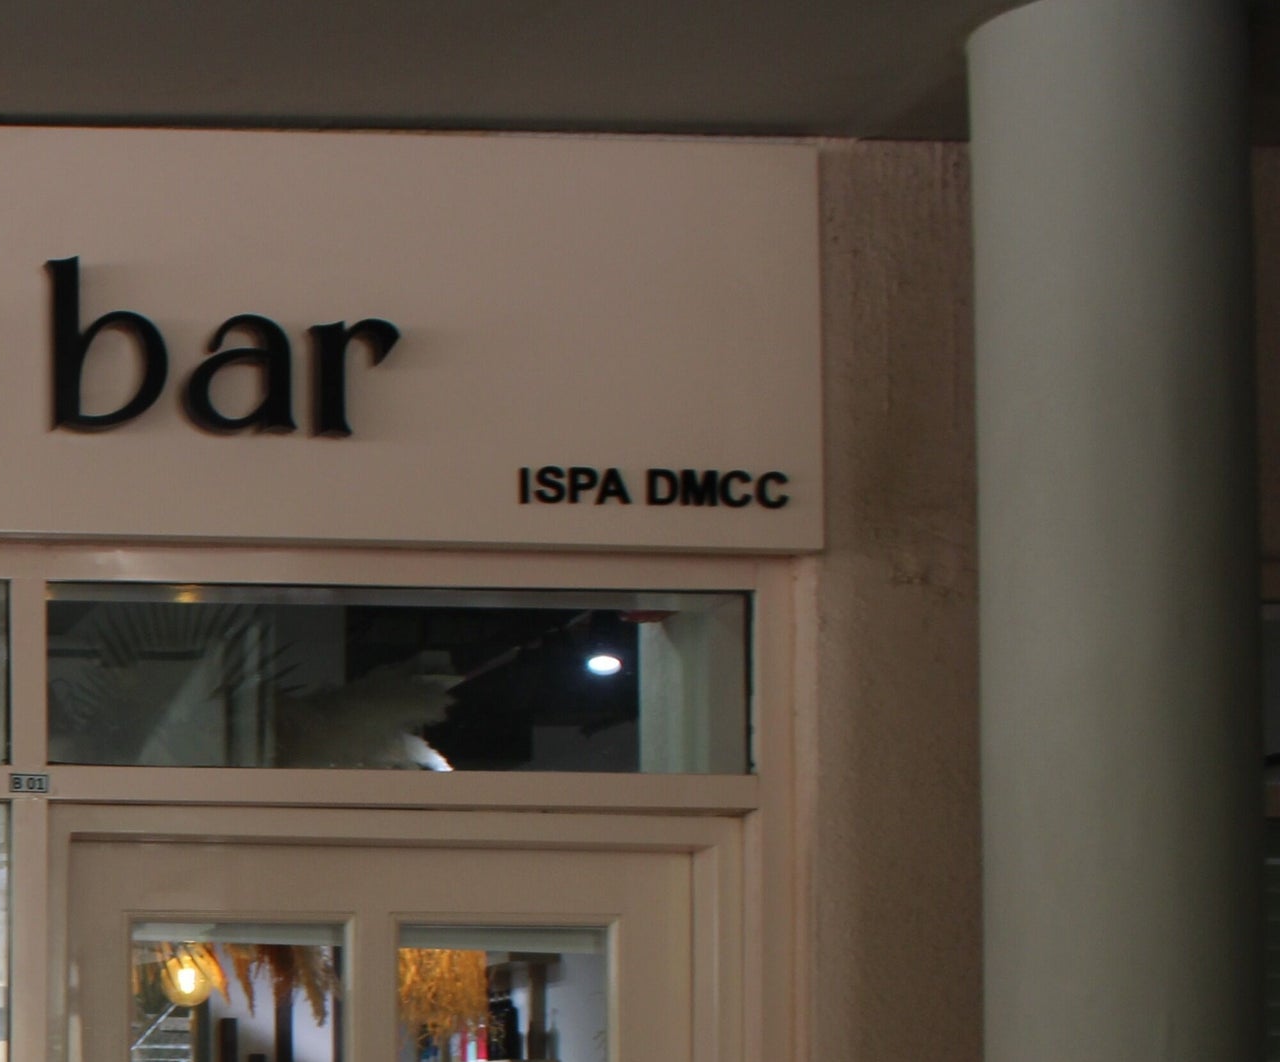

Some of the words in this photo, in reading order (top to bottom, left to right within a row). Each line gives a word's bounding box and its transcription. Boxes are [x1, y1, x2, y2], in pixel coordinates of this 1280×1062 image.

[46, 256, 400, 438] bar
[518, 466, 631, 505] ISPA
[646, 468, 789, 509] DMCC
